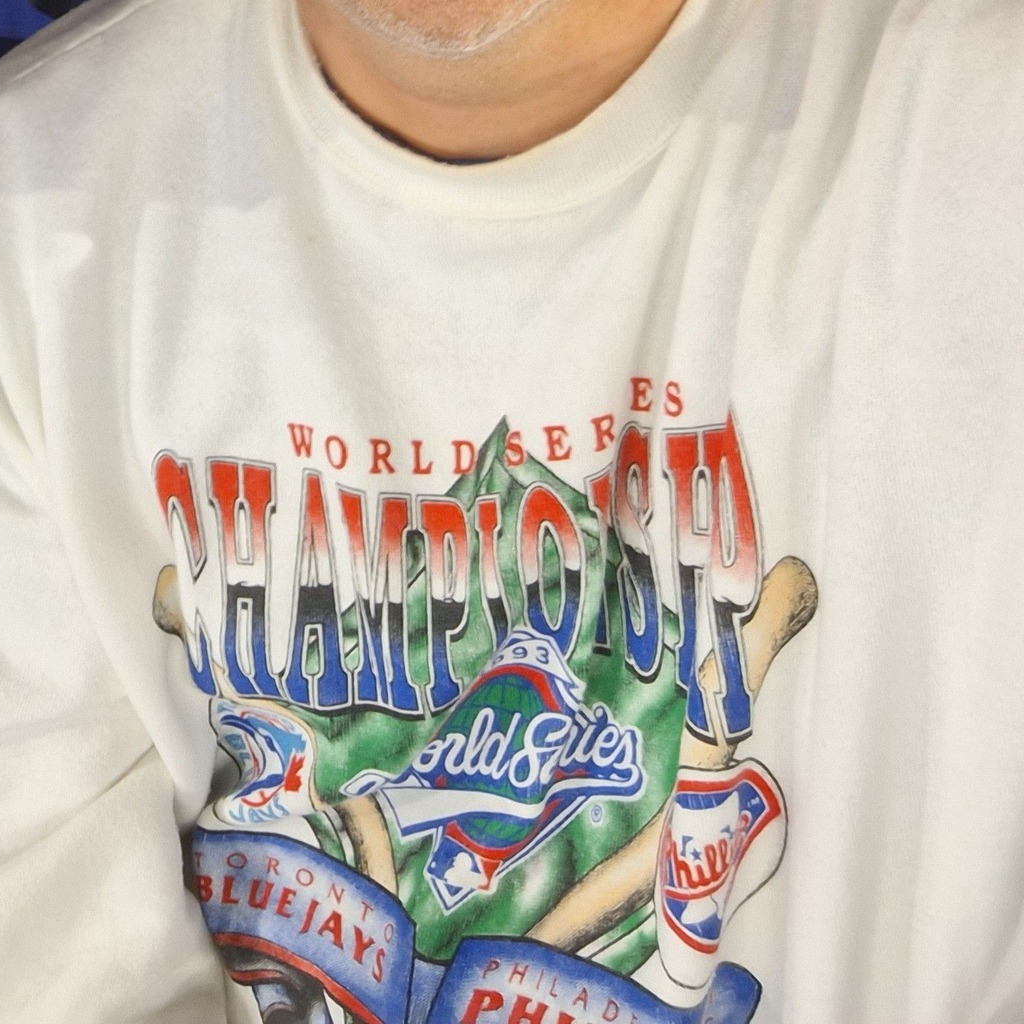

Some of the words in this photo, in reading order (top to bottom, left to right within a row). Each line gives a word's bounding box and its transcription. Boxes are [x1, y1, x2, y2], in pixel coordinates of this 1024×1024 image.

[286, 422, 477, 475] WORLD
[504, 377, 684, 467] SERES
[410, 706, 523, 781] orld
[193, 852, 394, 944] TORONTO
